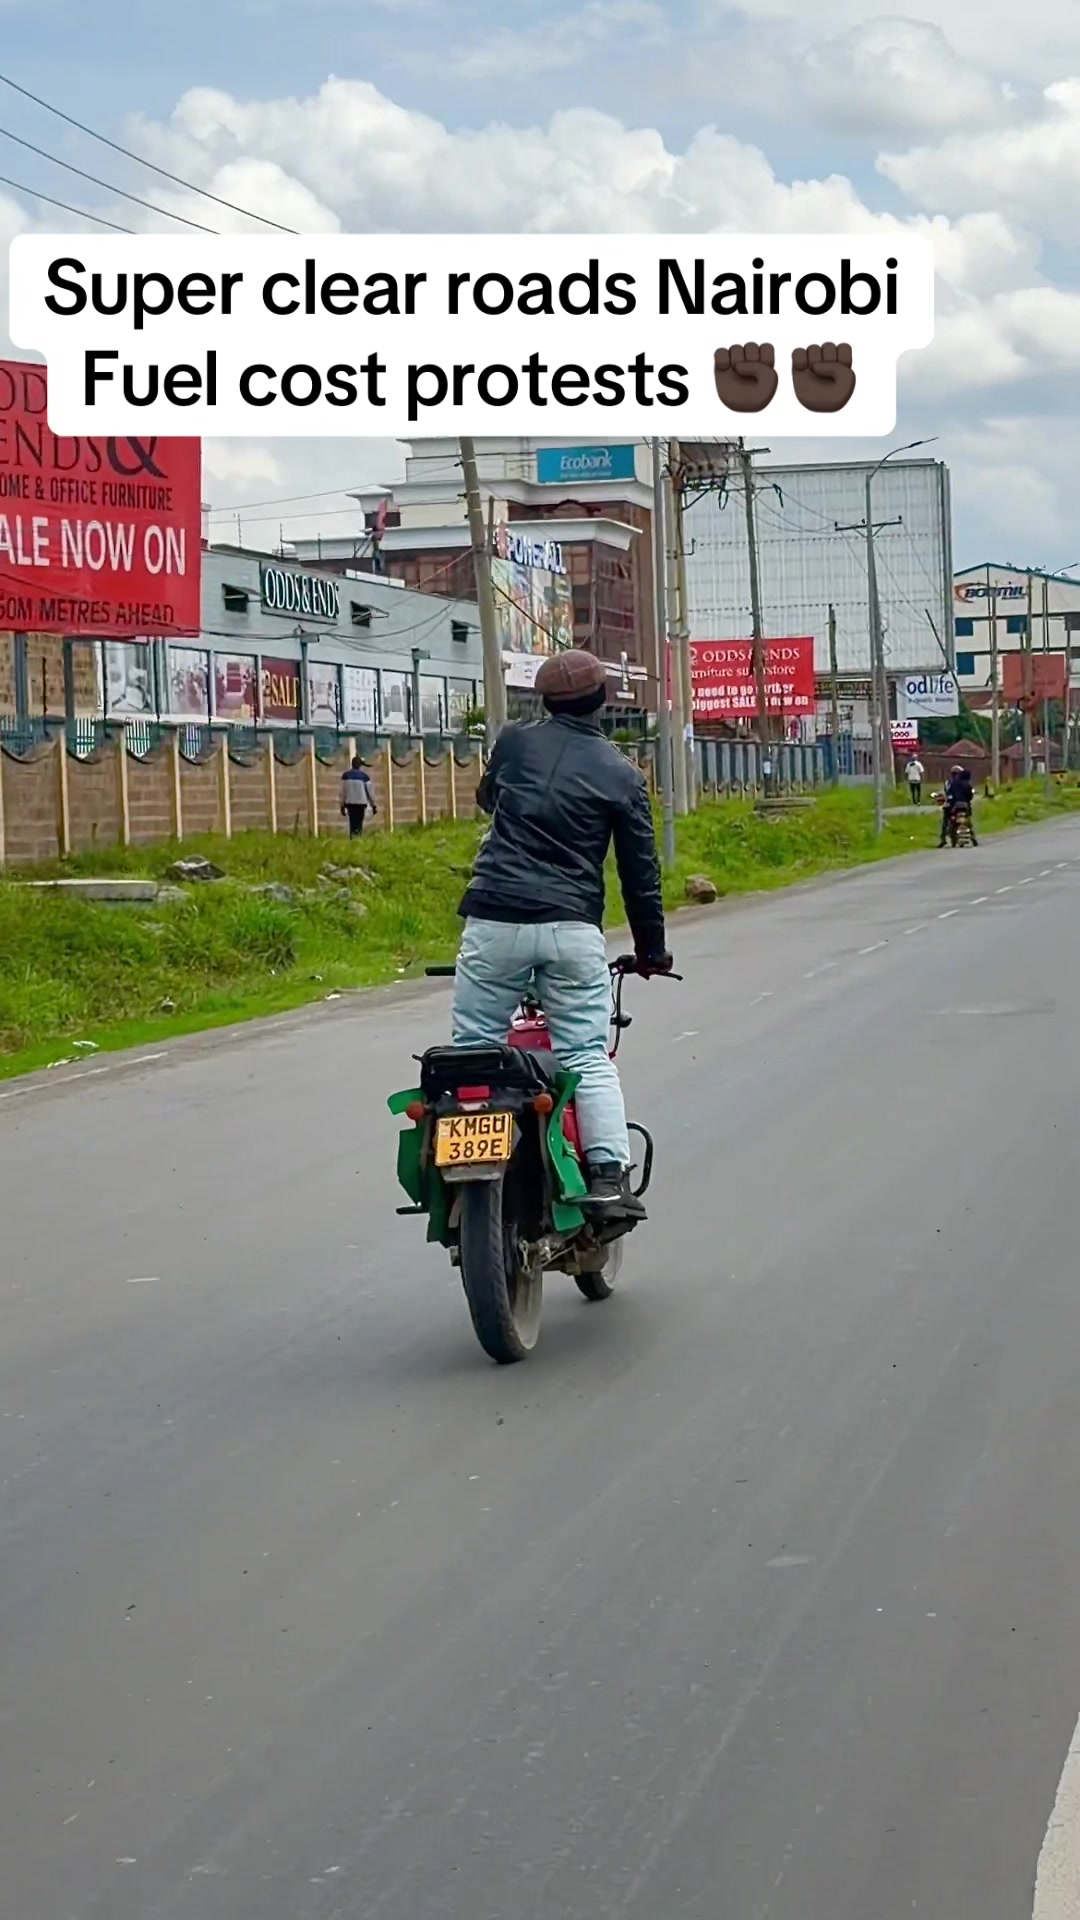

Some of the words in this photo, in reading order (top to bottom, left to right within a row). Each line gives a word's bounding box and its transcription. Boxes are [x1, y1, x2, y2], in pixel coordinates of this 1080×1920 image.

[561, 454, 612, 470] Ecobank
[35, 475, 45, 500] &
[51, 476, 97, 505] OFFICE
[102, 482, 174, 512] FURNITURE
[61, 518, 136, 572] NOW
[144, 525, 186, 576] ON
[40, 598, 110, 623] METRES
[702, 649, 746, 662] ODDS
[698, 684, 725, 697] need
[727, 685, 738, 696] to
[732, 696, 756, 708] SALE
[795, 696, 809, 706] on
[449, 1139, 503, 1160] 389E
